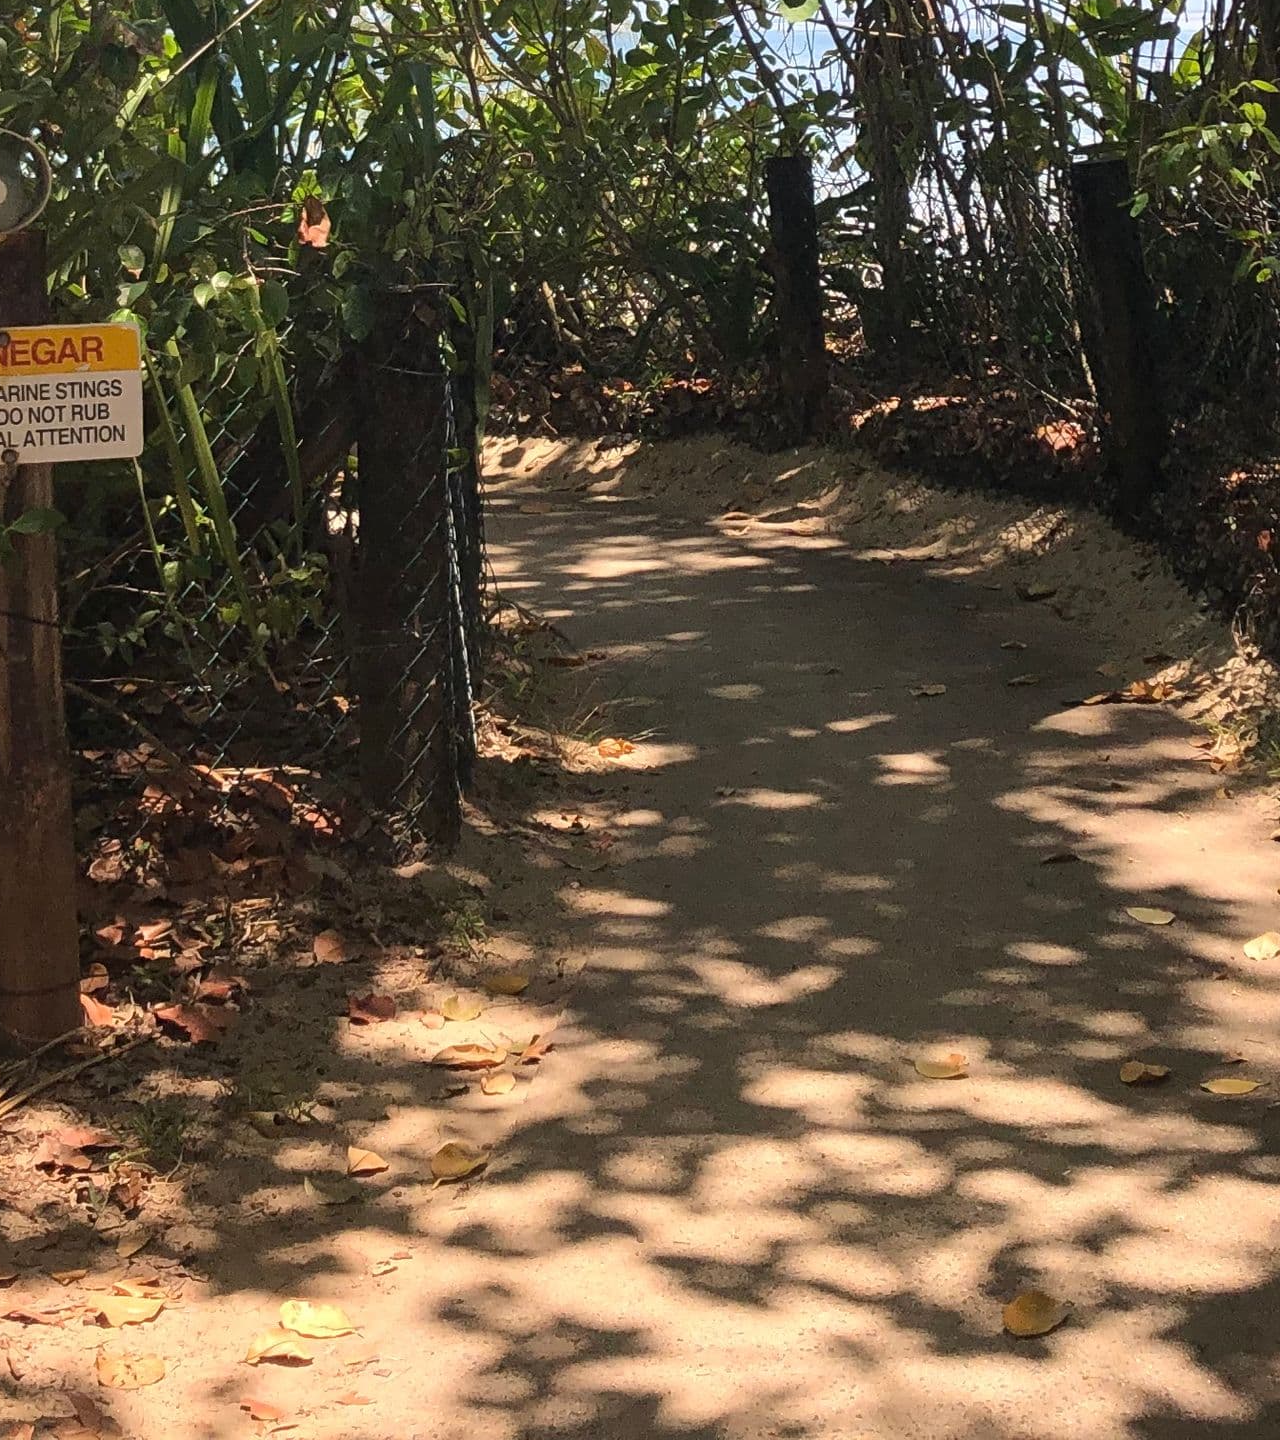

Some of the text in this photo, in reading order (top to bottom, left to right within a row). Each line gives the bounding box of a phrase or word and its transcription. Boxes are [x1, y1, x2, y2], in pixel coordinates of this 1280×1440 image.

[55, 379, 123, 399] STINGS
[28, 406, 67, 425] NOT
[71, 403, 110, 422] RUB
[23, 425, 126, 447] ATTENTION
